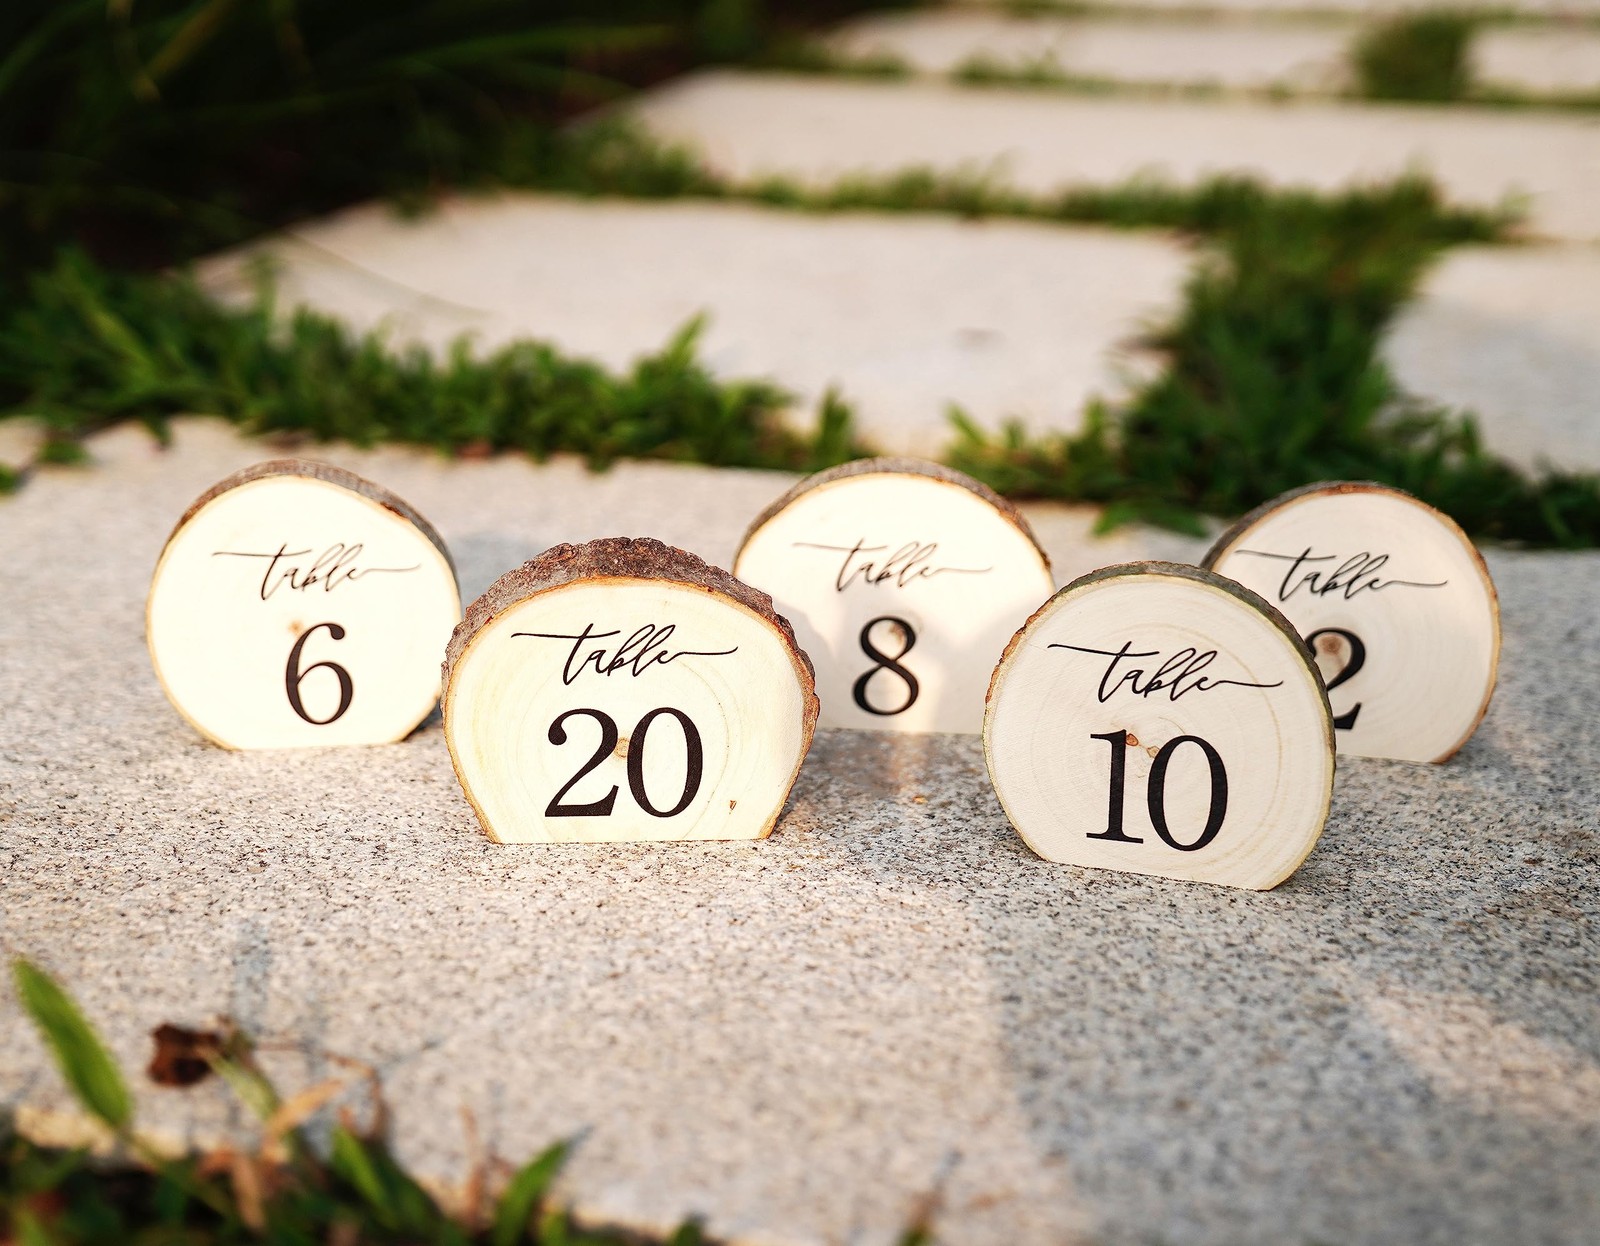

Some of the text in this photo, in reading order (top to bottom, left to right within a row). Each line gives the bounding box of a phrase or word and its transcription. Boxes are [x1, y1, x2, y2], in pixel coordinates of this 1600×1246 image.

[212, 543, 421, 601] table
[792, 537, 993, 594] table
[1235, 546, 1448, 601] table
[285, 622, 354, 726] 6
[511, 622, 739, 686] table
[852, 615, 920, 717] 8
[1047, 640, 1285, 704] table
[1304, 627, 1366, 731] 2
[545, 706, 704, 819] 20
[1085, 728, 1229, 852] 10
